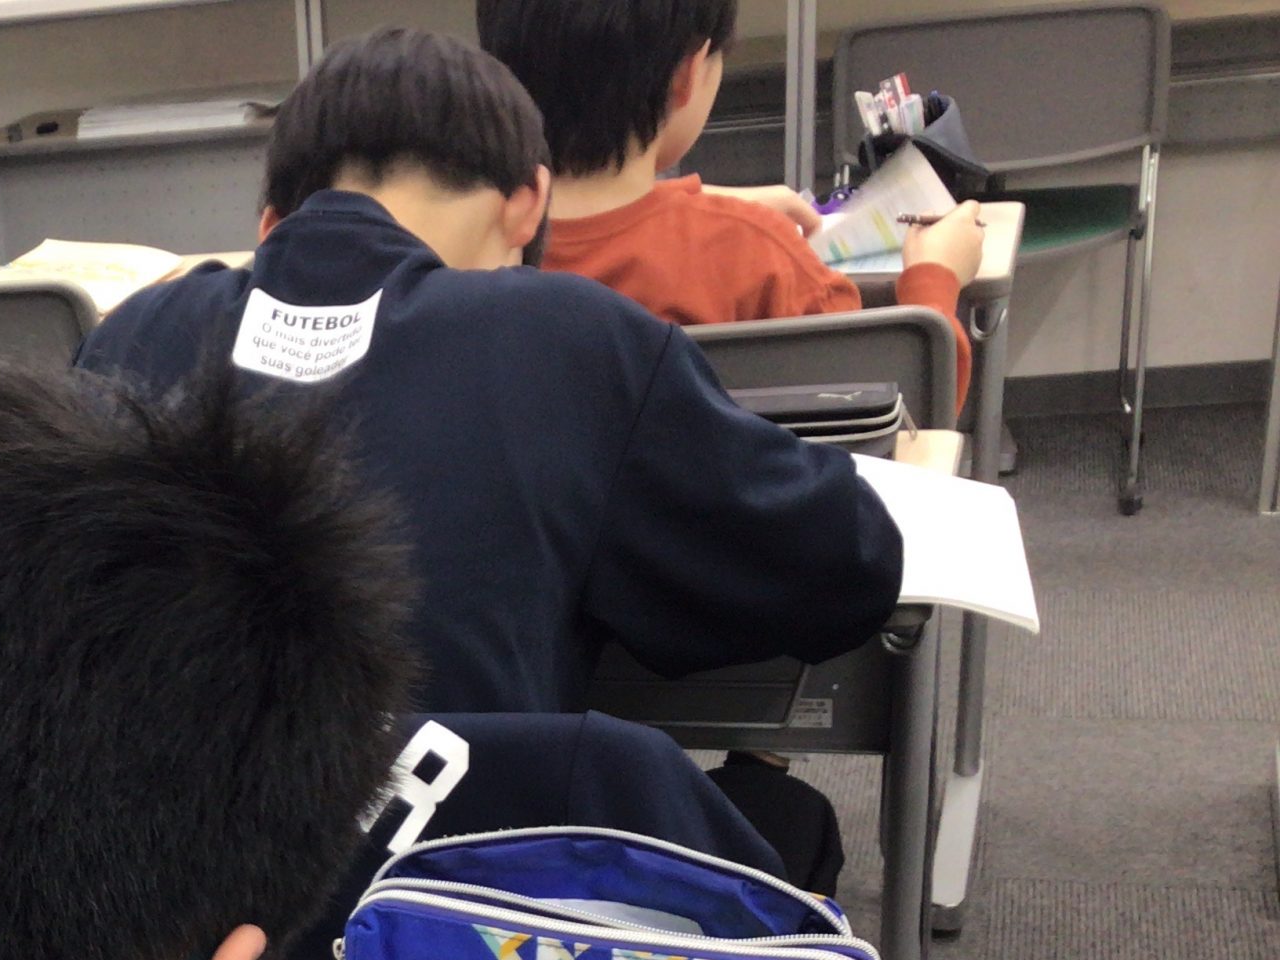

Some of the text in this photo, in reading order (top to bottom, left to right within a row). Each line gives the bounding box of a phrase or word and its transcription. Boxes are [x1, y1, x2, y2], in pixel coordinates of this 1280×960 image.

[271, 308, 361, 331] FUTEBOL
[262, 322, 362, 347] O mais divertido
[253, 335, 277, 348] que
[314, 345, 345, 363] pode
[260, 355, 292, 372] suas
